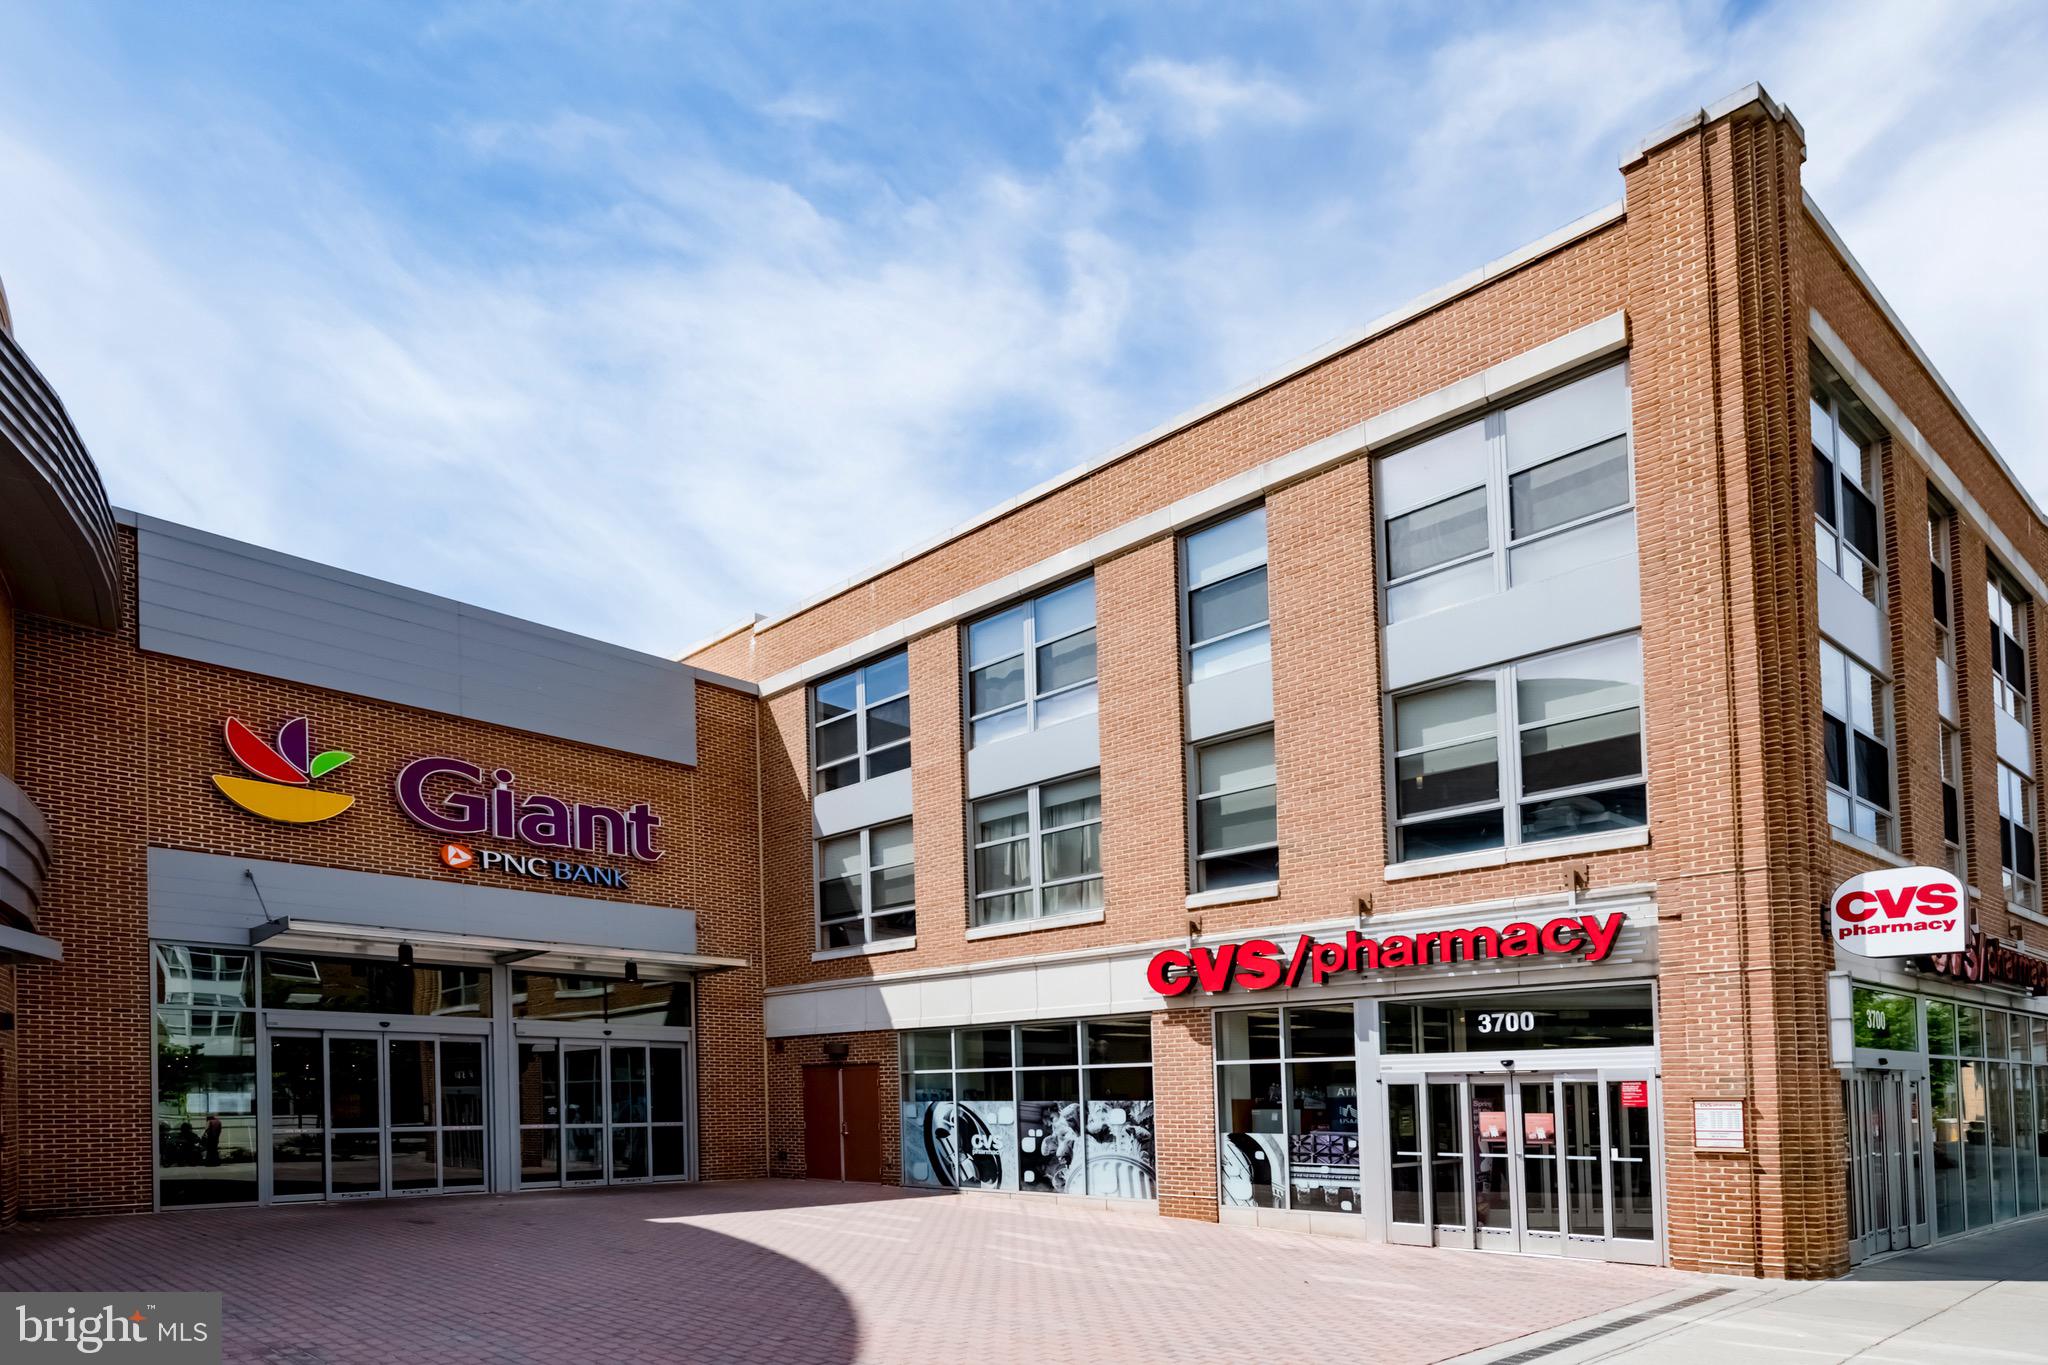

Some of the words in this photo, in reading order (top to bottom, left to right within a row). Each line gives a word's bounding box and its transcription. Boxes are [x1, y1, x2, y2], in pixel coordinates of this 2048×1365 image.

[395, 756, 666, 862] Giant
[480, 850, 548, 878] PNC
[554, 860, 631, 889] BANK
[1836, 883, 1958, 922] CVS
[1839, 919, 1956, 940] pharmacy
[1477, 1011, 1535, 1033] 3700
[1866, 1009, 1886, 1030] 3700
[1336, 1087, 1357, 1097] ATM
[971, 1134, 1003, 1150] CVS
